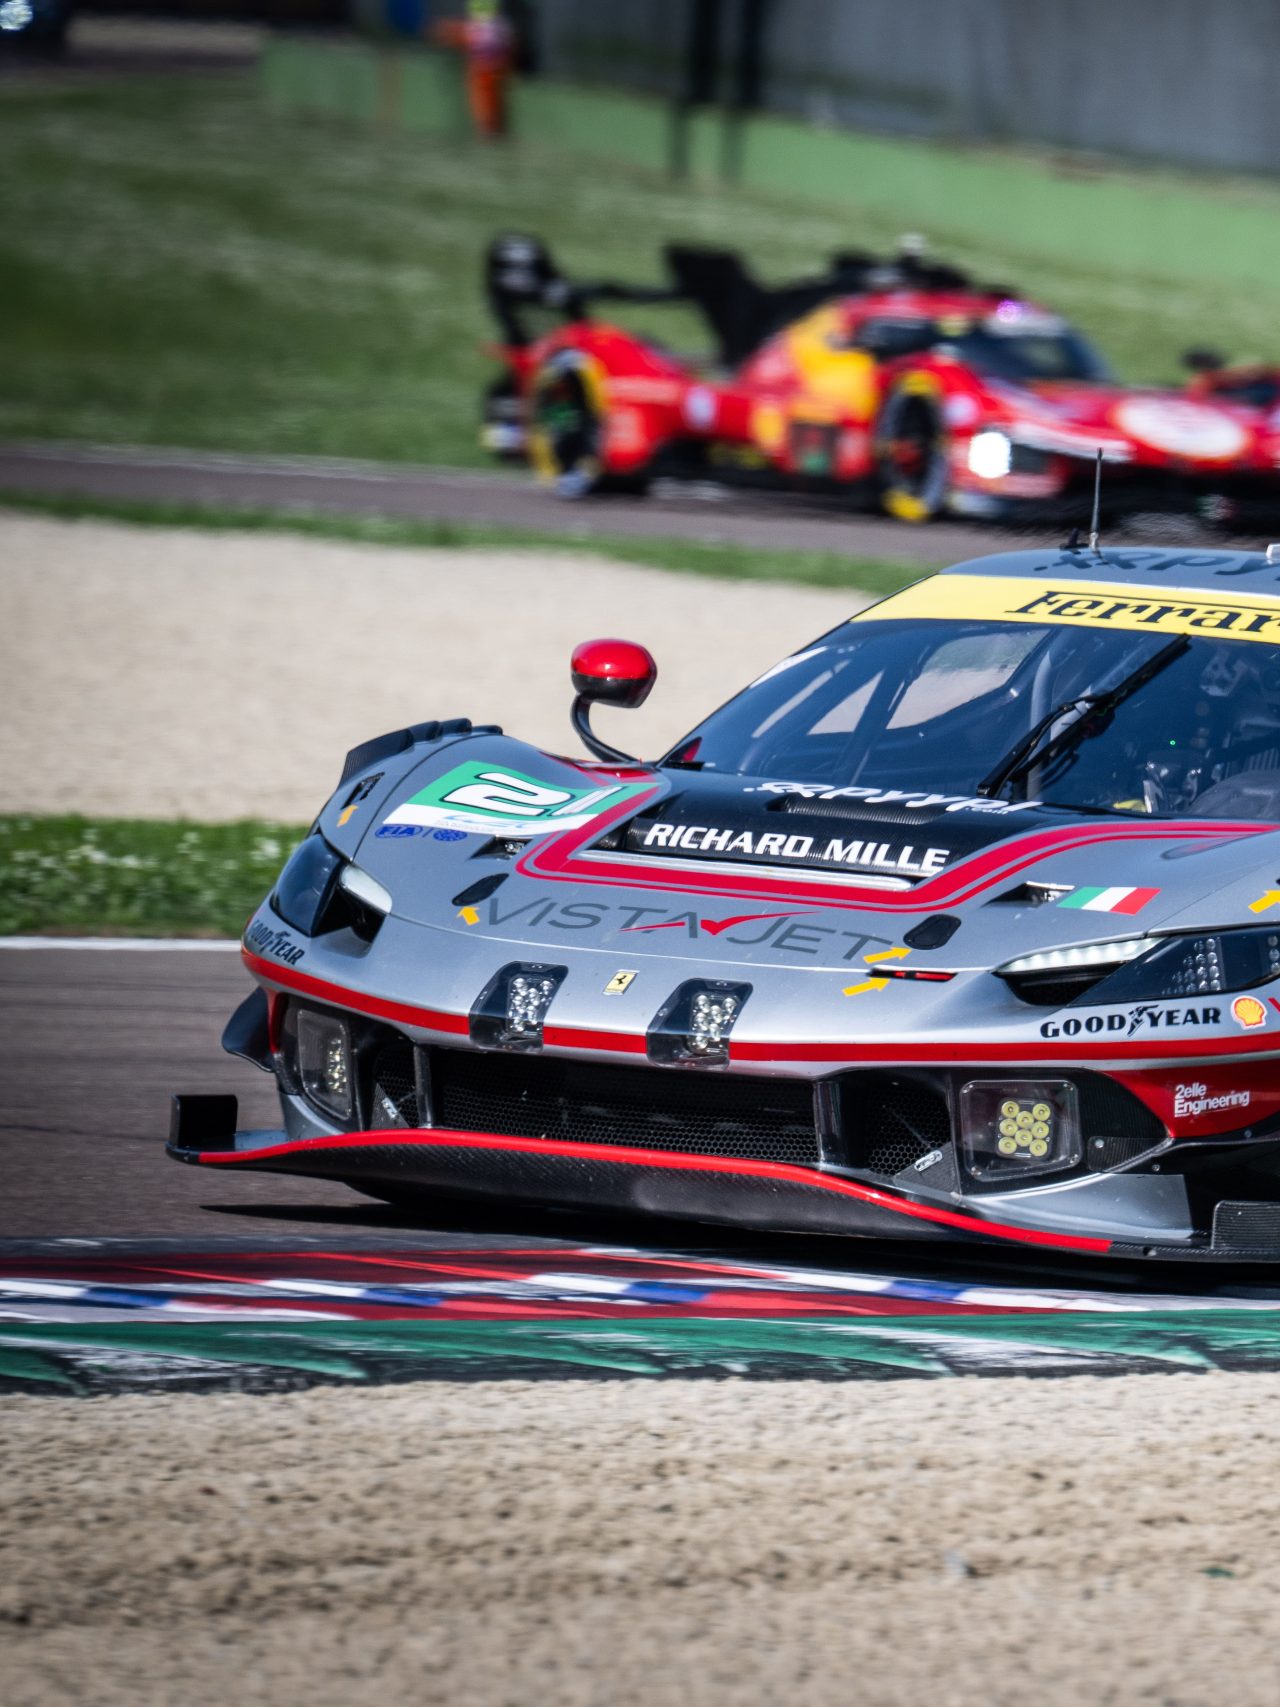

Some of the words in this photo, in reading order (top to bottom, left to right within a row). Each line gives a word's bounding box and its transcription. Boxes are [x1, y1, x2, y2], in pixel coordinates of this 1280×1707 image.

[438, 772, 630, 817] 21
[818, 786, 1043, 813] pyypl
[643, 822, 814, 858] RICHARD
[823, 838, 951, 875] MILLE
[1174, 1083, 1208, 1101] 2elle
[1174, 1090, 1251, 1115] Engineering
